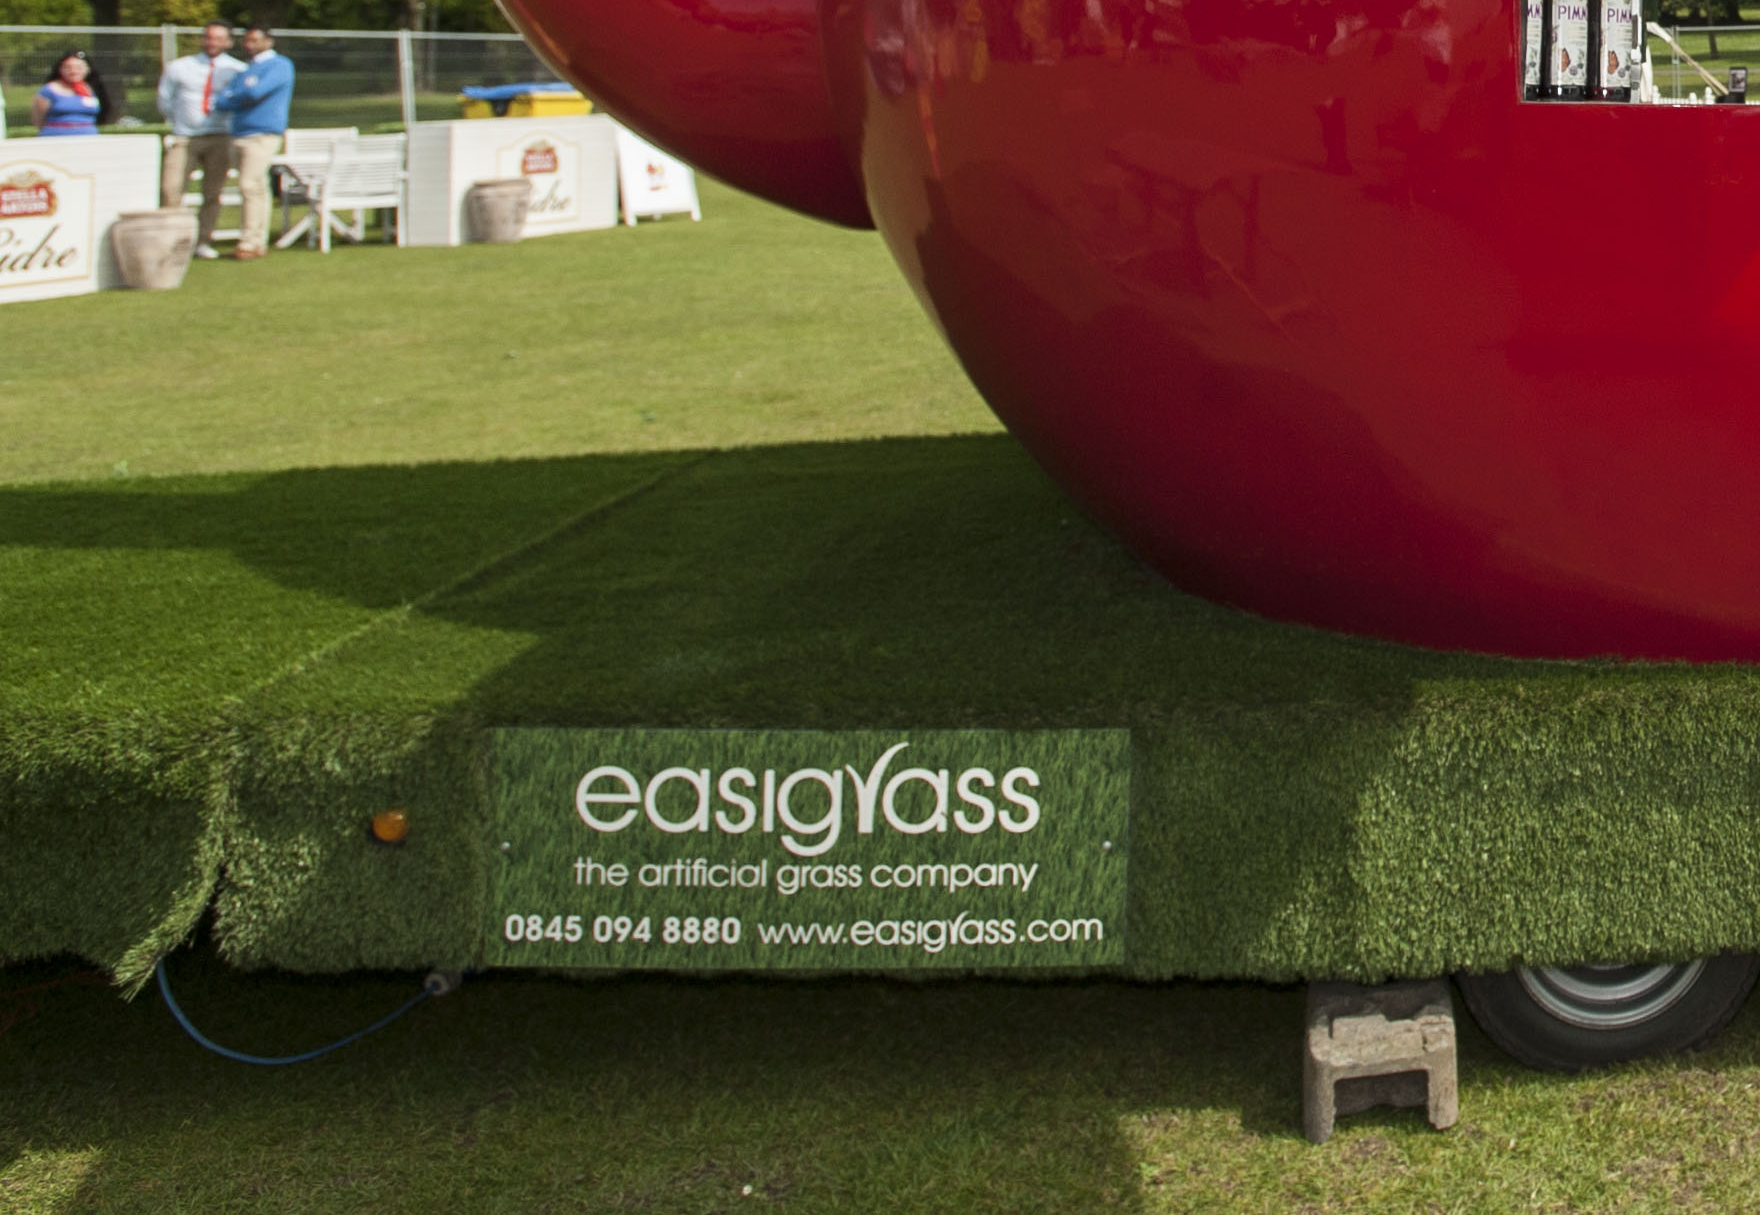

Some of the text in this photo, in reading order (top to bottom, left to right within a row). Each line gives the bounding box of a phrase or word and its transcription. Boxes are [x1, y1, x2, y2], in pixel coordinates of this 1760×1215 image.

[575, 741, 1041, 857] easigrass
[573, 856, 1039, 895] the artificial grass company
[504, 910, 1104, 953] 0845 094 8880 www.easigrass.com
